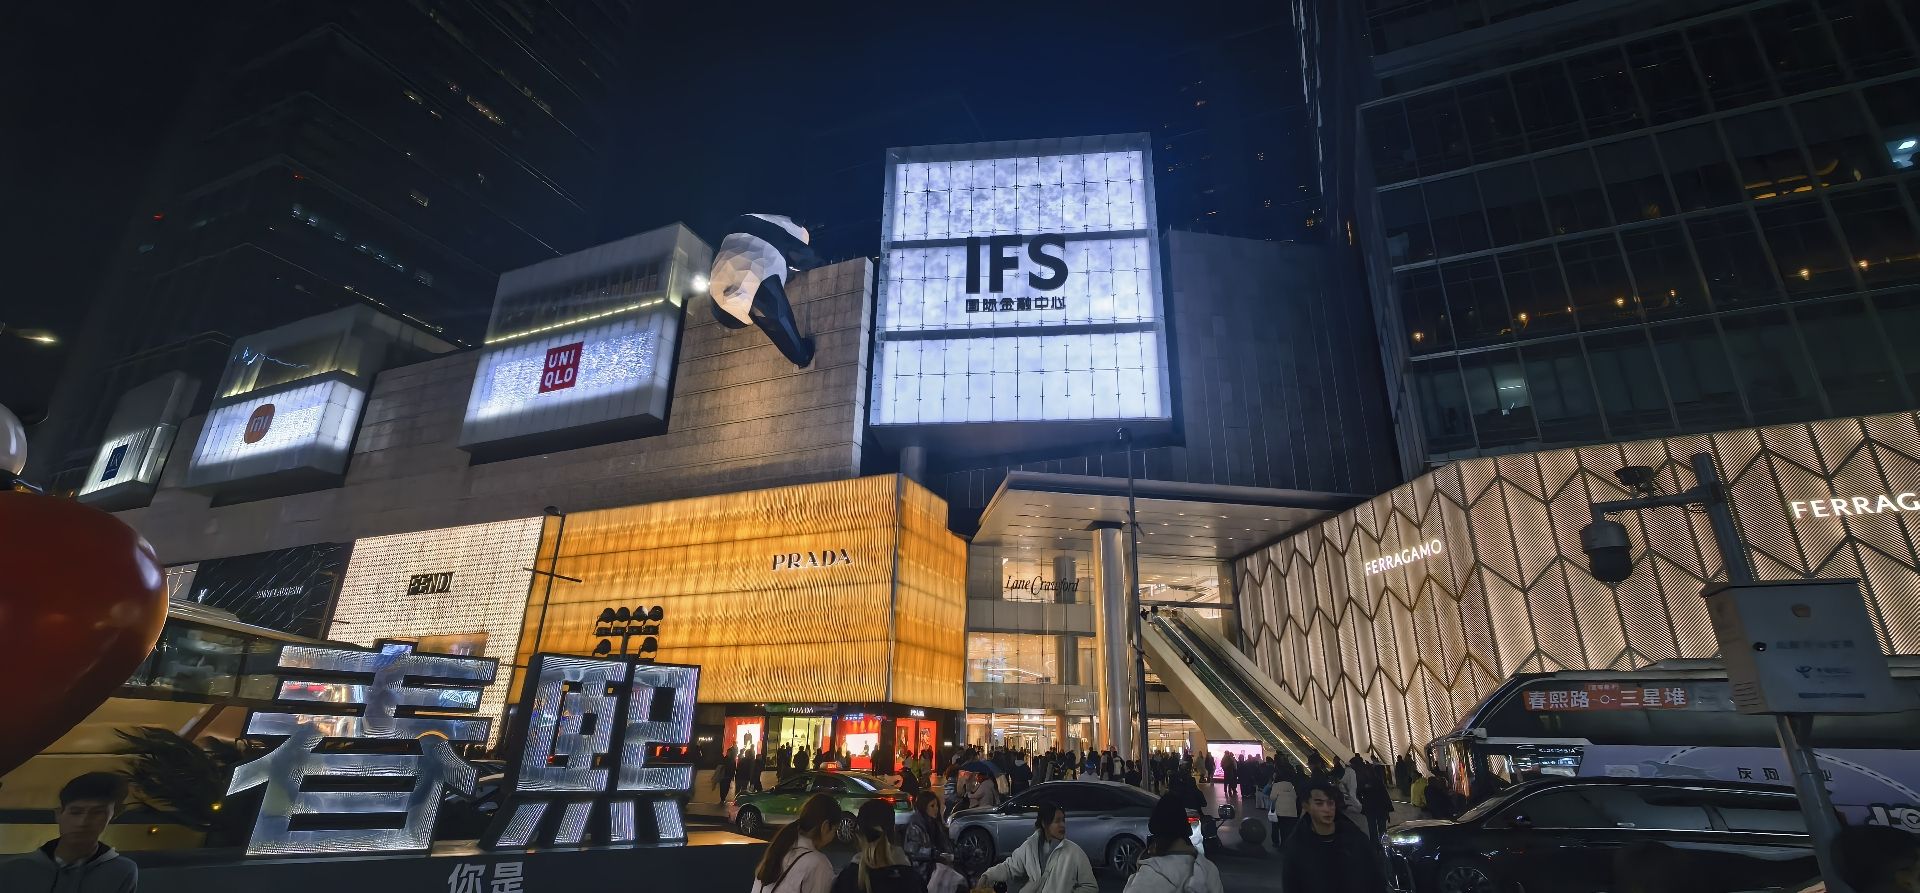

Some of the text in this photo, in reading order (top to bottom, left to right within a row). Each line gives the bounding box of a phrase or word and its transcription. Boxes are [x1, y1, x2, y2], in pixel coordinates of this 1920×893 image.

[965, 233, 1069, 294] IFS
[966, 296, 1066, 313] 国际金融中心
[549, 349, 575, 368] UNI
[544, 367, 574, 388] QLO
[772, 548, 853, 571] PRADA
[1365, 539, 1442, 576] FERRAGAMO
[408, 571, 455, 595] FENDI
[1003, 575, 1080, 595] Lane Crawford
[1528, 690, 1590, 710] 春熙路
[1620, 687, 1686, 707] 三星堆
[226, 638, 701, 857] 春熙
[447, 861, 525, 893] 你是
